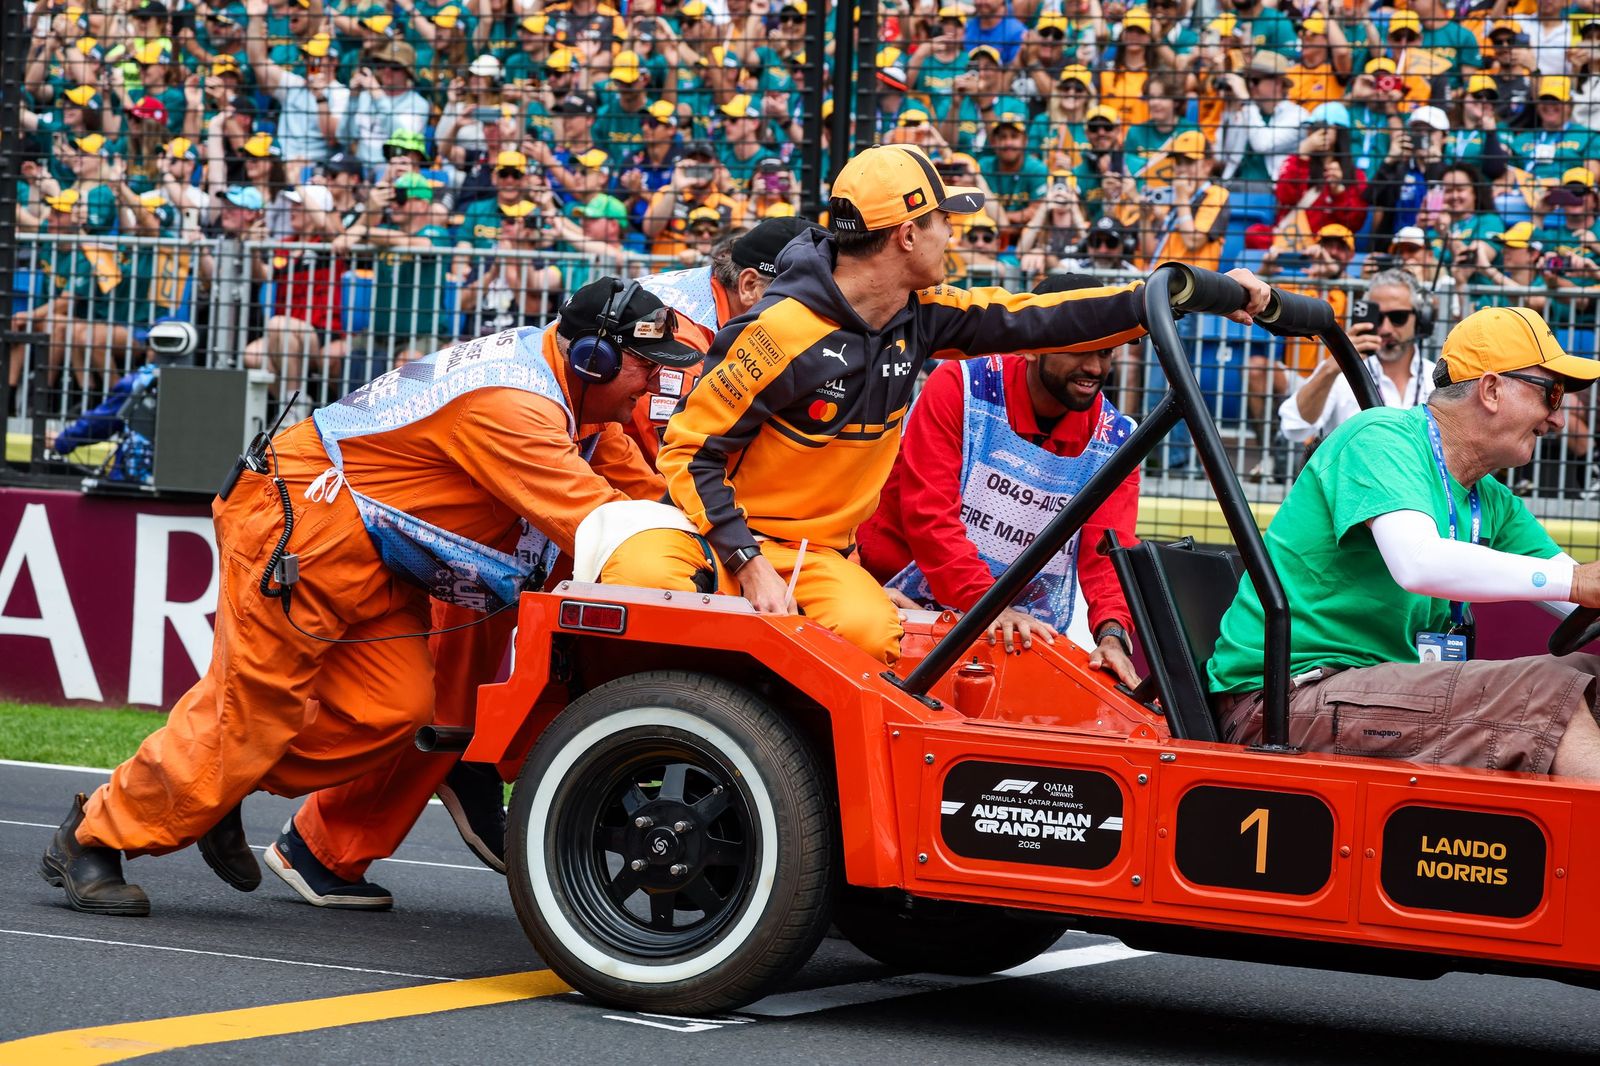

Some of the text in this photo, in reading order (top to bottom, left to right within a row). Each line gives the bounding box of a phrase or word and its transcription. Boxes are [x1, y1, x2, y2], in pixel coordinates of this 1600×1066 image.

[755, 330, 779, 359] Hilton
[736, 348, 763, 381] okta
[708, 378, 736, 408] freshworks
[716, 369, 743, 400] PIRELLI
[986, 472, 1067, 513] 0849-AUS
[960, 503, 994, 532] FIRE
[1043, 782, 1074, 794] QATAR
[1050, 791, 1074, 799] AIRWAYS
[981, 794, 1016, 804] FORMULA
[1027, 798, 1051, 807] QATAR
[1052, 800, 1084, 810] AIRWAYS
[971, 804, 1092, 828] AUSTRALIAN
[974, 819, 1087, 843] GRAND PRIX
[1240, 807, 1270, 874] 1
[1018, 840, 1041, 850] 2026
[1421, 835, 1507, 861] LANDO
[1416, 859, 1509, 886] NORRIS
